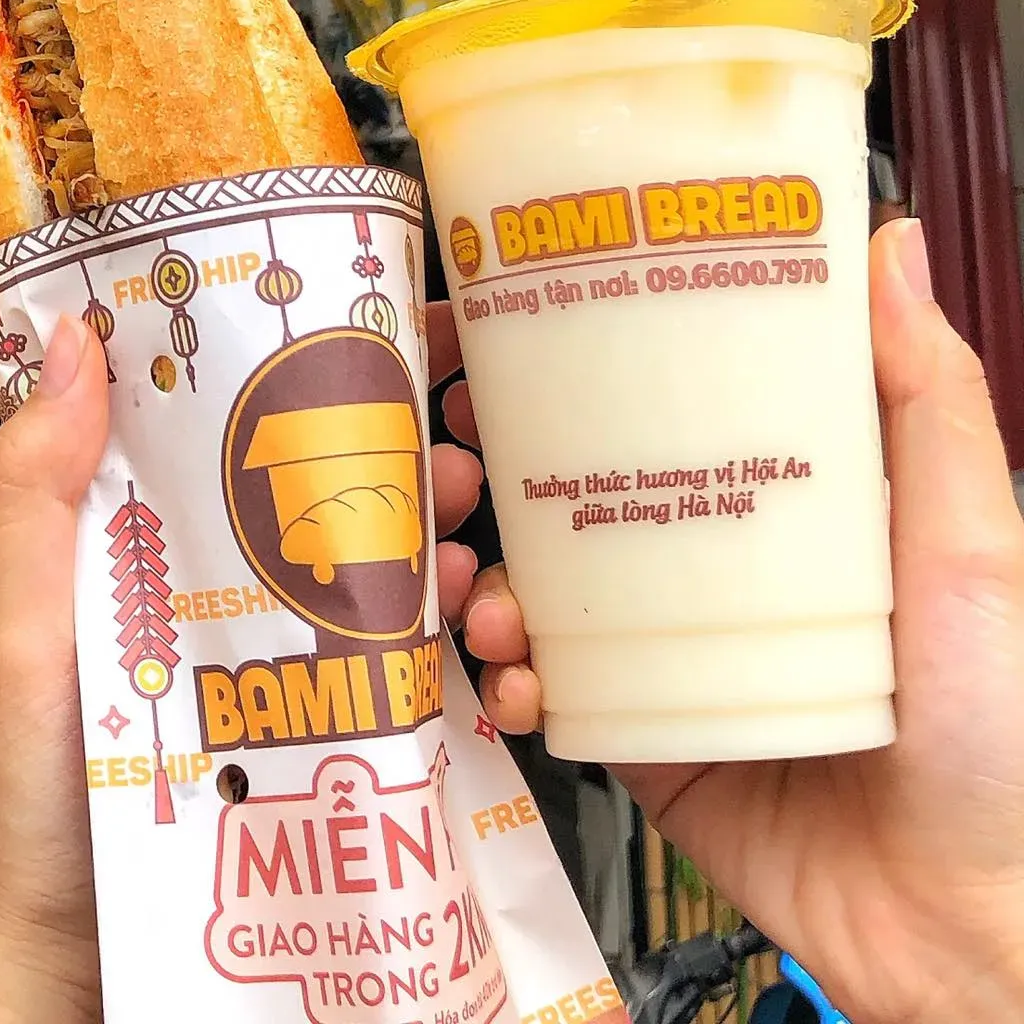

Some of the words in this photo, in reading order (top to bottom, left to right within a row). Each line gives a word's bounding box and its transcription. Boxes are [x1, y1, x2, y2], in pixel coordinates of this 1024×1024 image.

[491, 186, 638, 267] BAMI
[640, 176, 823, 245] BREAD
[112, 251, 262, 310] FRHIP
[492, 289, 540, 315] hàng
[544, 279, 584, 310] tận
[645, 257, 829, 293] 09.6600.7970
[522, 474, 582, 501] Thưởng
[585, 470, 632, 494] thức
[636, 467, 709, 490] hương
[714, 460, 736, 488] vị
[741, 456, 778, 485] Hội
[782, 456, 812, 480] An
[572, 501, 618, 532] giữa
[622, 500, 673, 525] lòng
[677, 493, 712, 521] Hà
[715, 491, 756, 520] Nội
[199, 653, 378, 747] BAMI
[236, 779, 437, 898] MIỄN
[470, 795, 538, 841] FRE
[227, 921, 318, 959] GIAO
[326, 912, 435, 957] HÀNG
[312, 961, 441, 1007] TRONG
